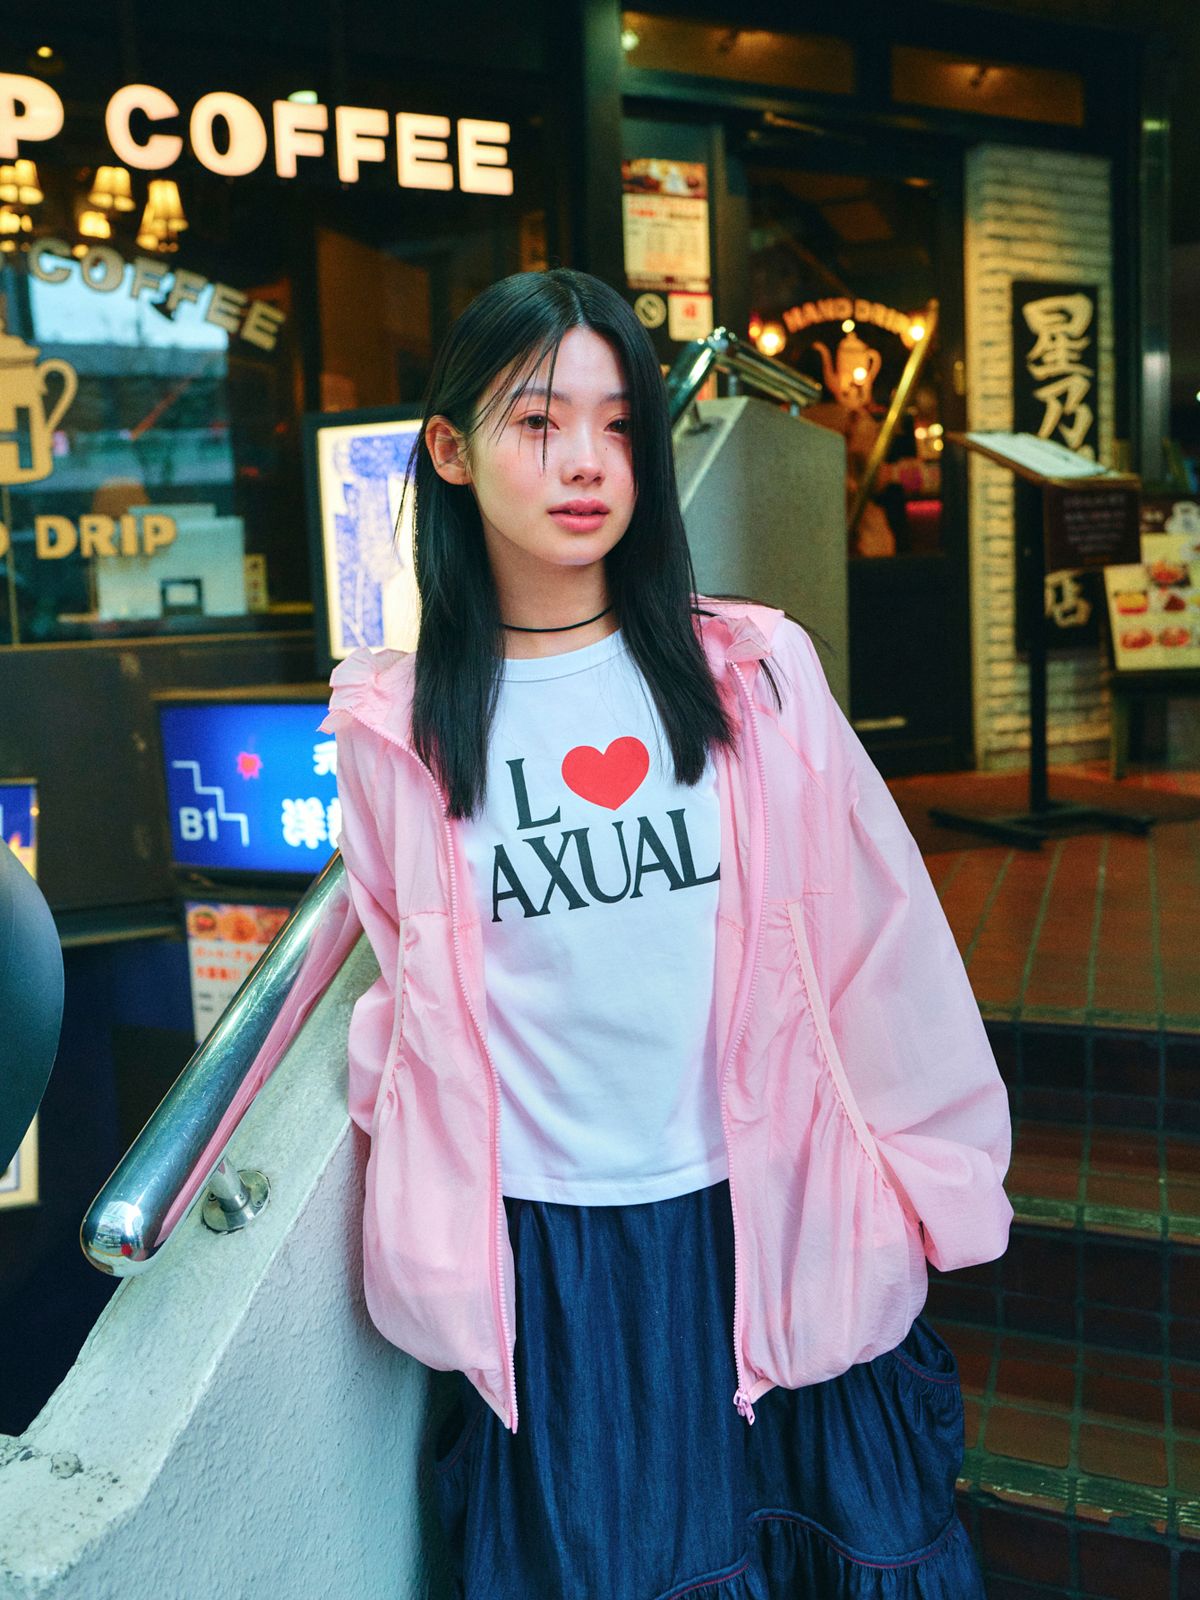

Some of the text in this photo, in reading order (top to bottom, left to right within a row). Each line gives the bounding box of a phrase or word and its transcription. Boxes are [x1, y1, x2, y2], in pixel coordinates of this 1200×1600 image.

[105, 83, 514, 197] COFFEE
[27, 237, 288, 352] COFFEE
[34, 513, 178, 560] DRIP
[178, 806, 219, 842] B1
[505, 758, 561, 830] L
[491, 808, 721, 922] AXUAL
